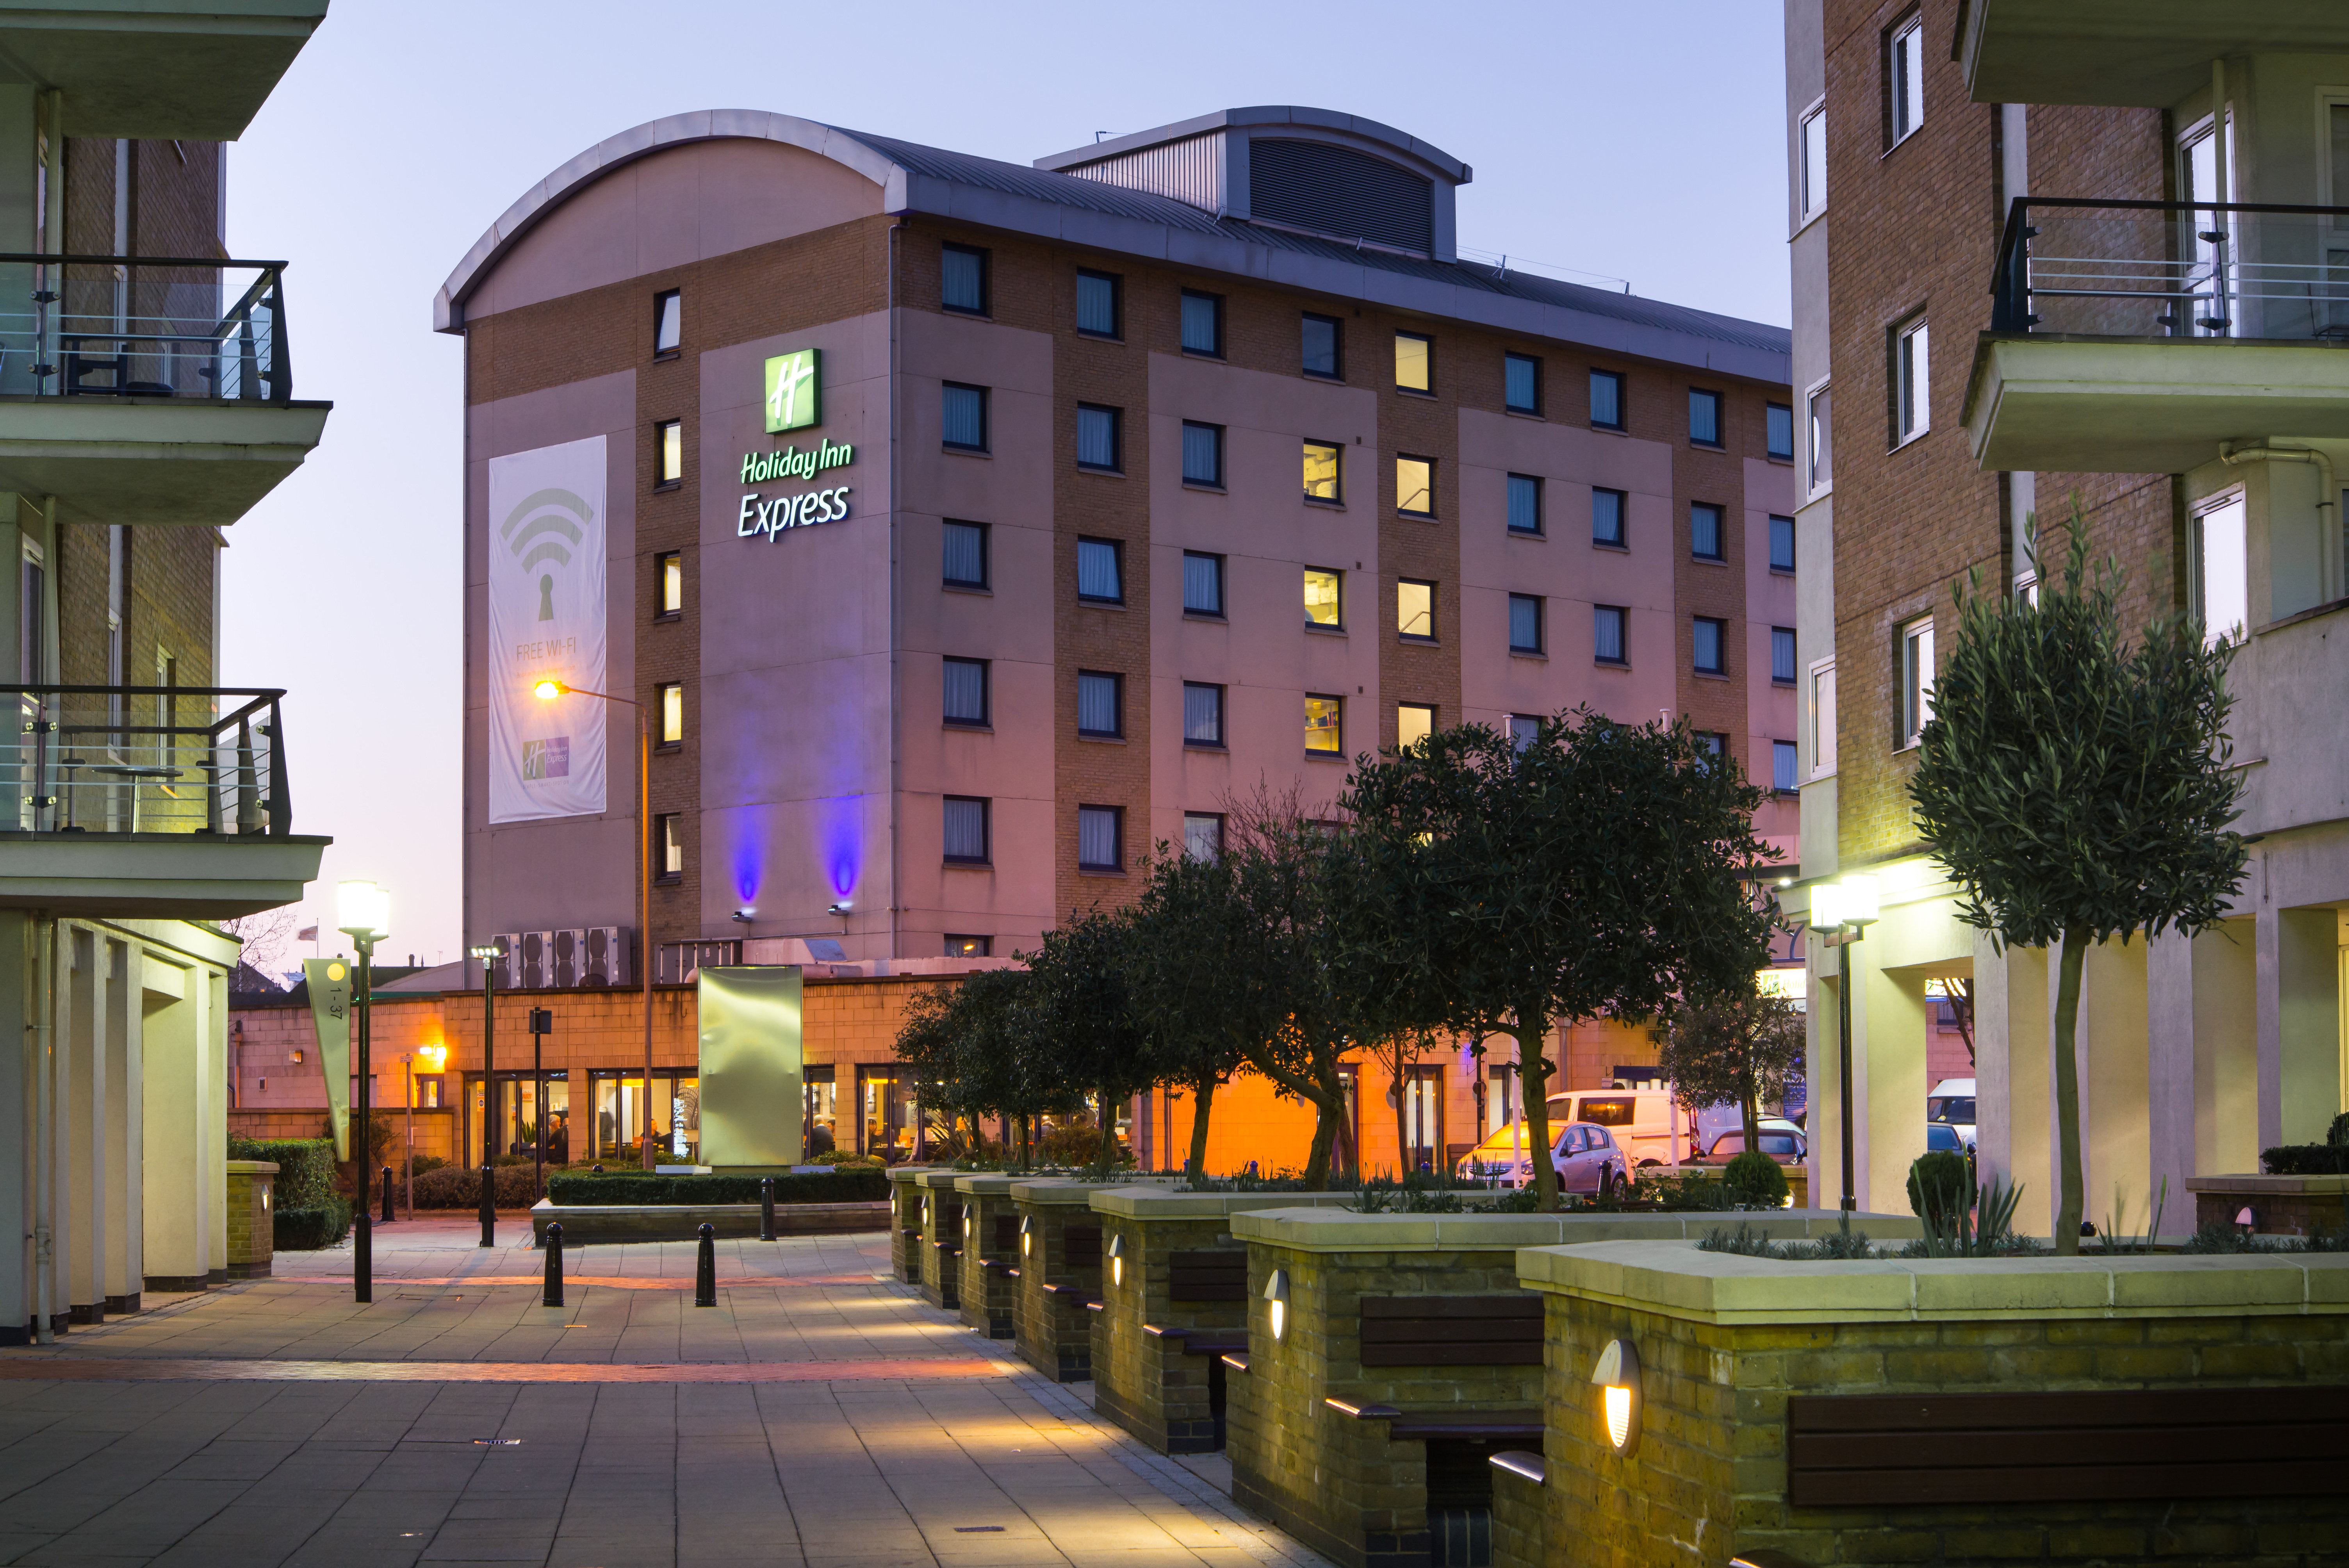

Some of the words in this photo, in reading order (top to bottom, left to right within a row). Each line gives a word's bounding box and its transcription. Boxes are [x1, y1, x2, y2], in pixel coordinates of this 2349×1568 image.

[740, 446, 817, 484] Holiday
[820, 438, 852, 470] Inn
[738, 486, 850, 543] Express
[517, 641, 543, 662] FREE
[546, 636, 576, 657] WI-FI
[547, 754, 567, 764] Express
